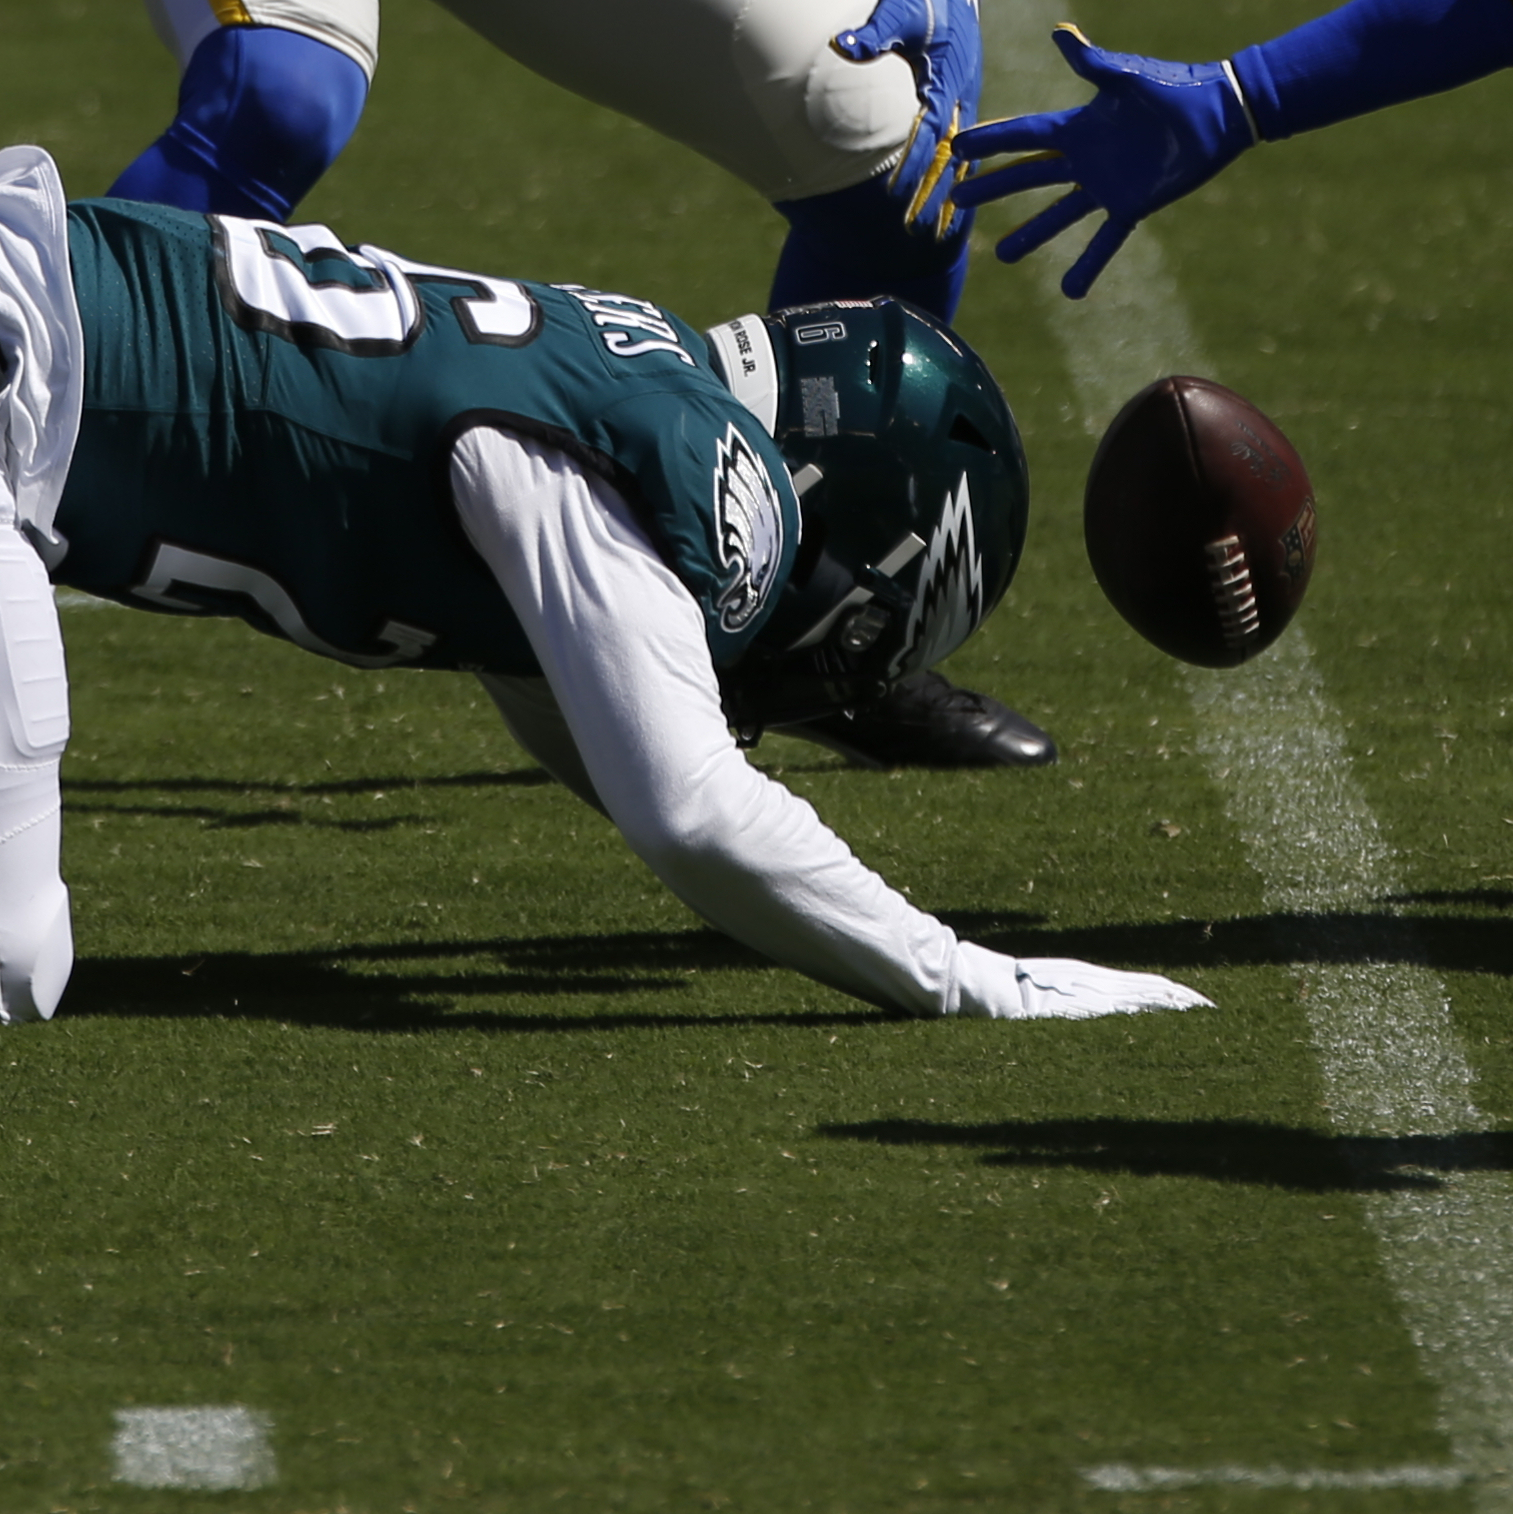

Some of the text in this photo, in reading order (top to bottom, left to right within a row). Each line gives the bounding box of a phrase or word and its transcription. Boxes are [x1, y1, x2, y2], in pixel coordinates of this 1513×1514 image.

[735, 331, 753, 356] ROSE
[796, 321, 846, 344] 6
[742, 358, 757, 377] JR.
